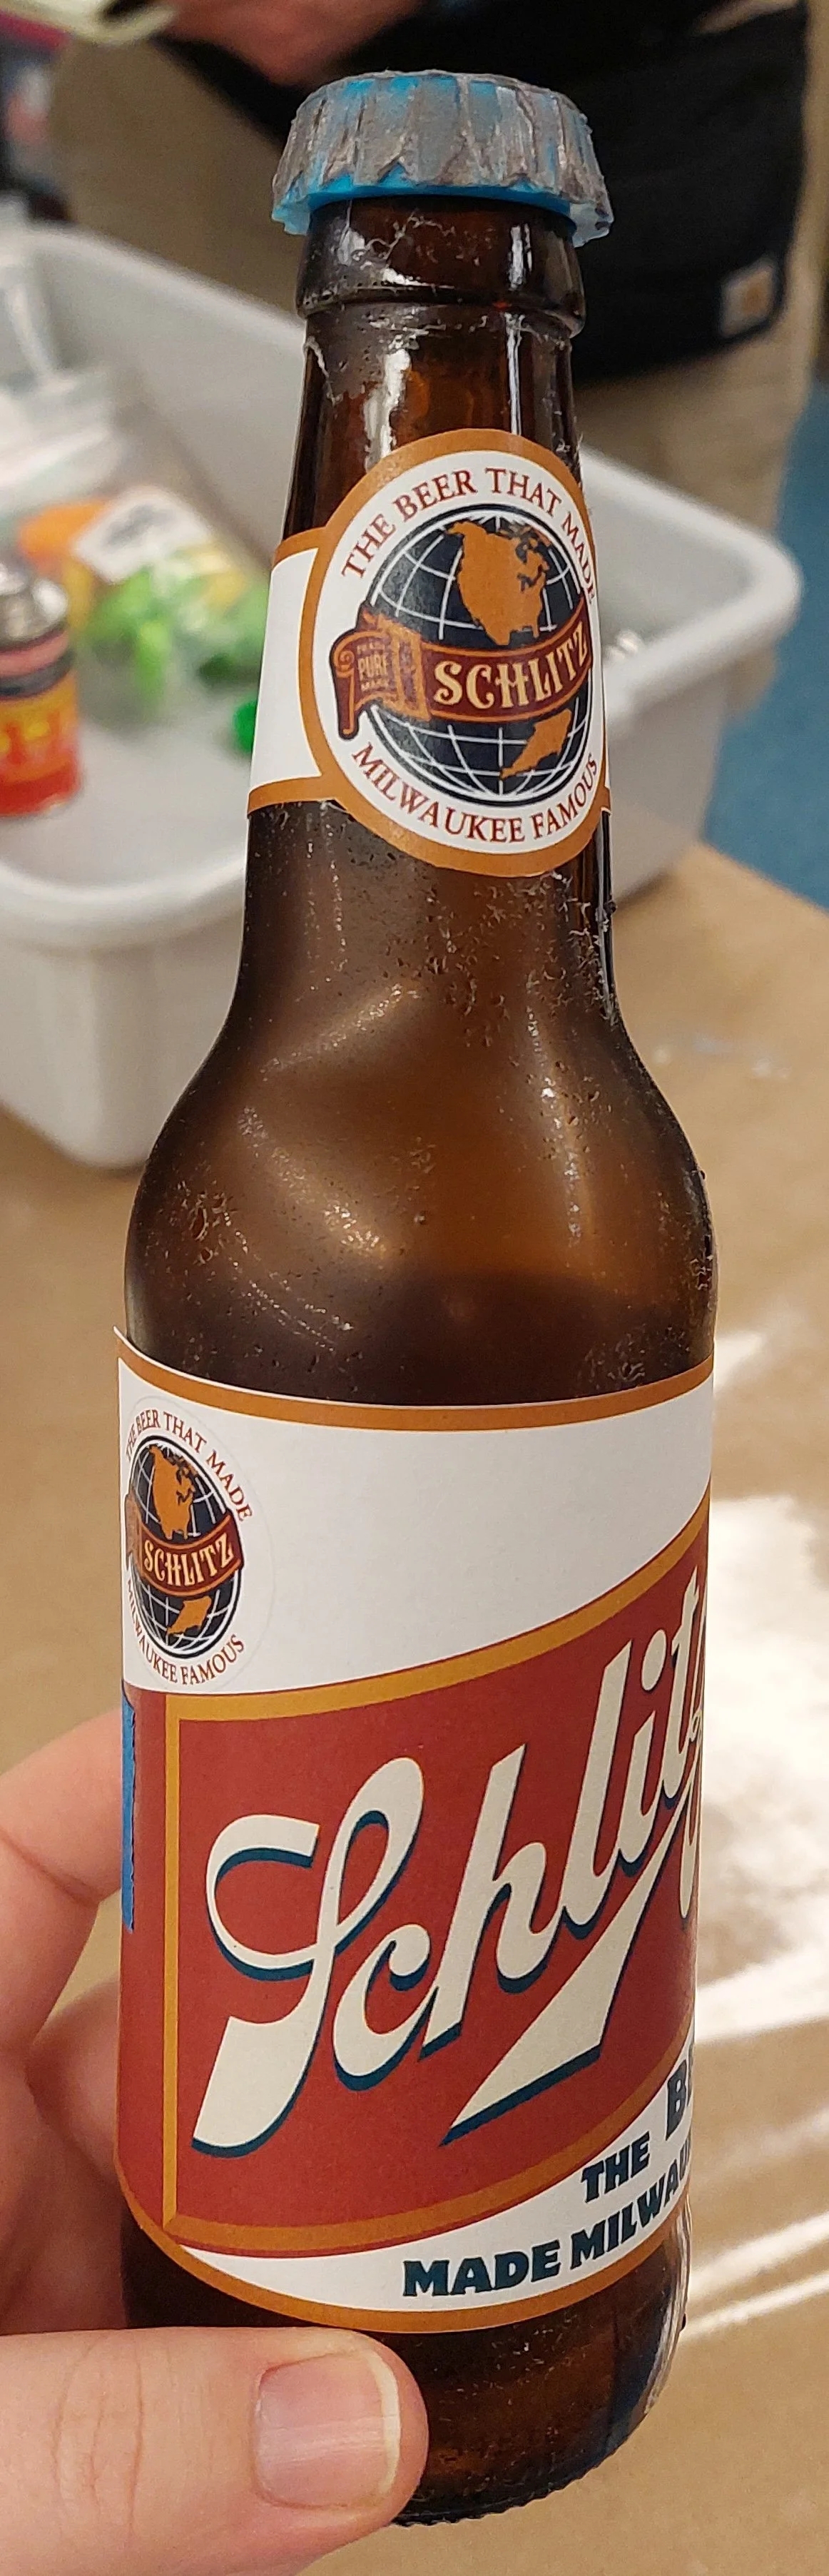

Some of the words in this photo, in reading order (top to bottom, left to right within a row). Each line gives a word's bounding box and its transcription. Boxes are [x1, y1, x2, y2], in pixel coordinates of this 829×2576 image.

[341, 513, 397, 579] THE
[392, 468, 478, 522] BEER
[485, 467, 562, 518] THAT
[561, 511, 595, 604] MADE
[433, 620, 591, 710] SCHLITZ
[351, 742, 526, 844] MILWAUKEE
[532, 754, 599, 843] FAMOUS
[136, 1409, 161, 1436] BEER
[163, 1411, 208, 1454] THAT
[205, 1450, 253, 1522] MADE
[143, 1531, 235, 1588] SCHLITZ
[127, 1578, 178, 1683] MILWAUKEE
[180, 1633, 245, 1685] FAMOUS
[581, 2131, 651, 2204] THE
[665, 2045, 693, 2141] B
[402, 2239, 561, 2298] MADE
[570, 2129, 692, 2271] MILWAU
